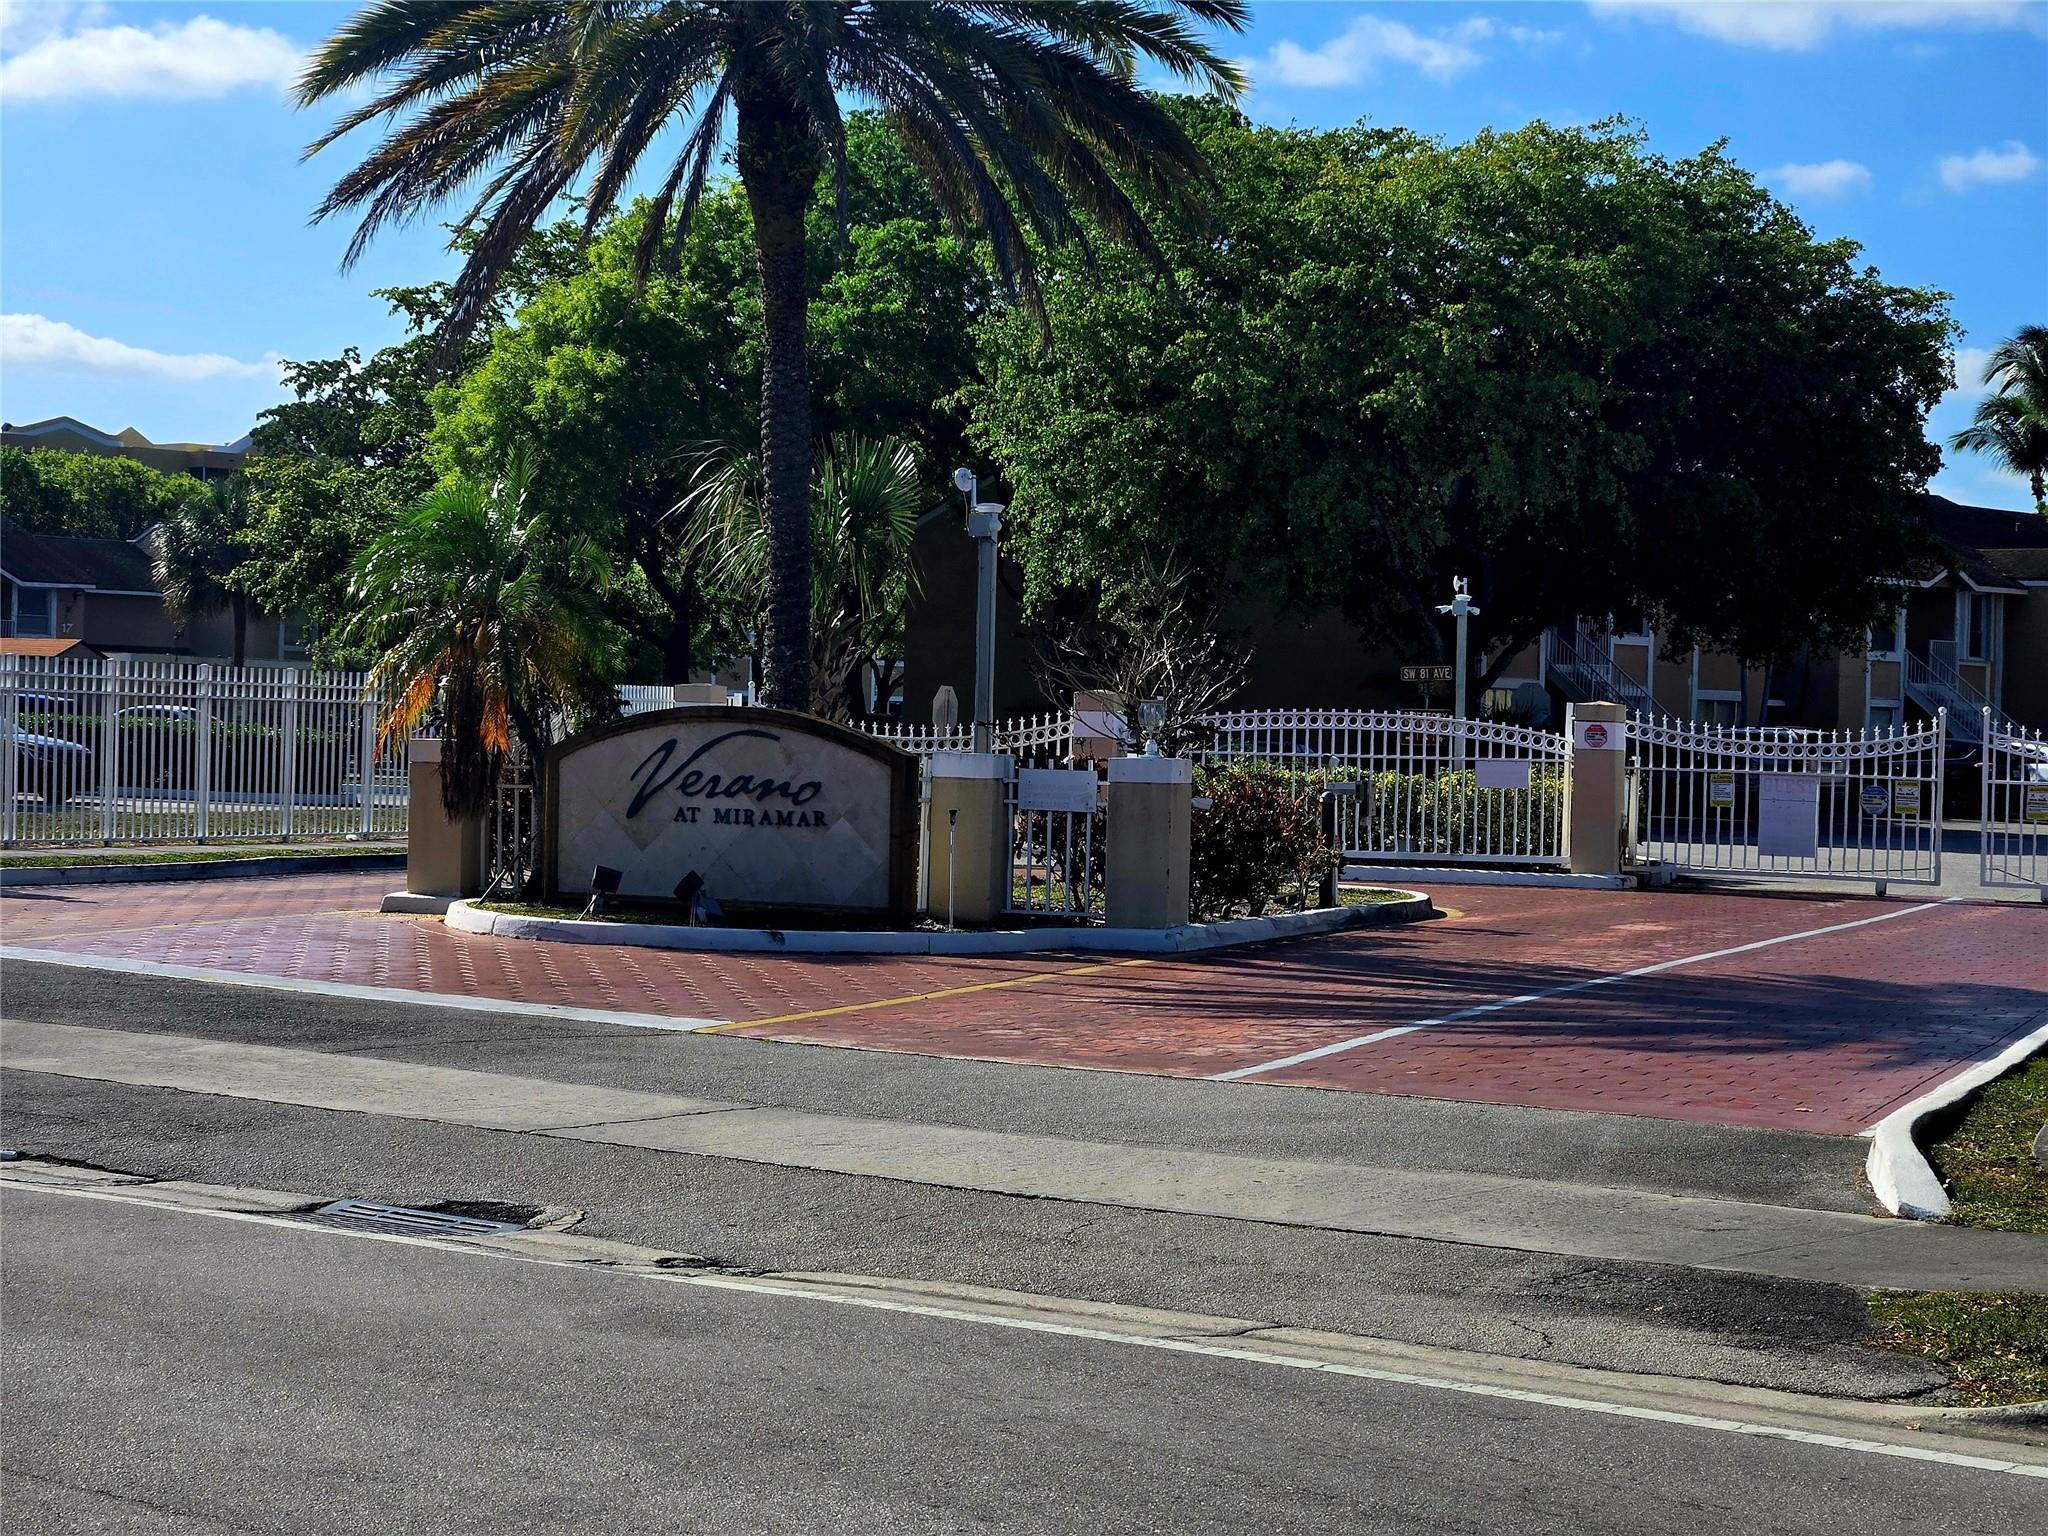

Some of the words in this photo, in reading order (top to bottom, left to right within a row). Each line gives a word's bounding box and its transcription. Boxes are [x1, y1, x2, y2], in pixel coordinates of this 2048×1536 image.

[62, 623, 74, 633] 17
[1403, 668, 1416, 679] SW
[1420, 668, 1429, 679] 81
[1433, 667, 1450, 679] AVE
[626, 729, 823, 819] Verano
[673, 807, 701, 823] AT
[714, 808, 827, 826] MIRAMAR
